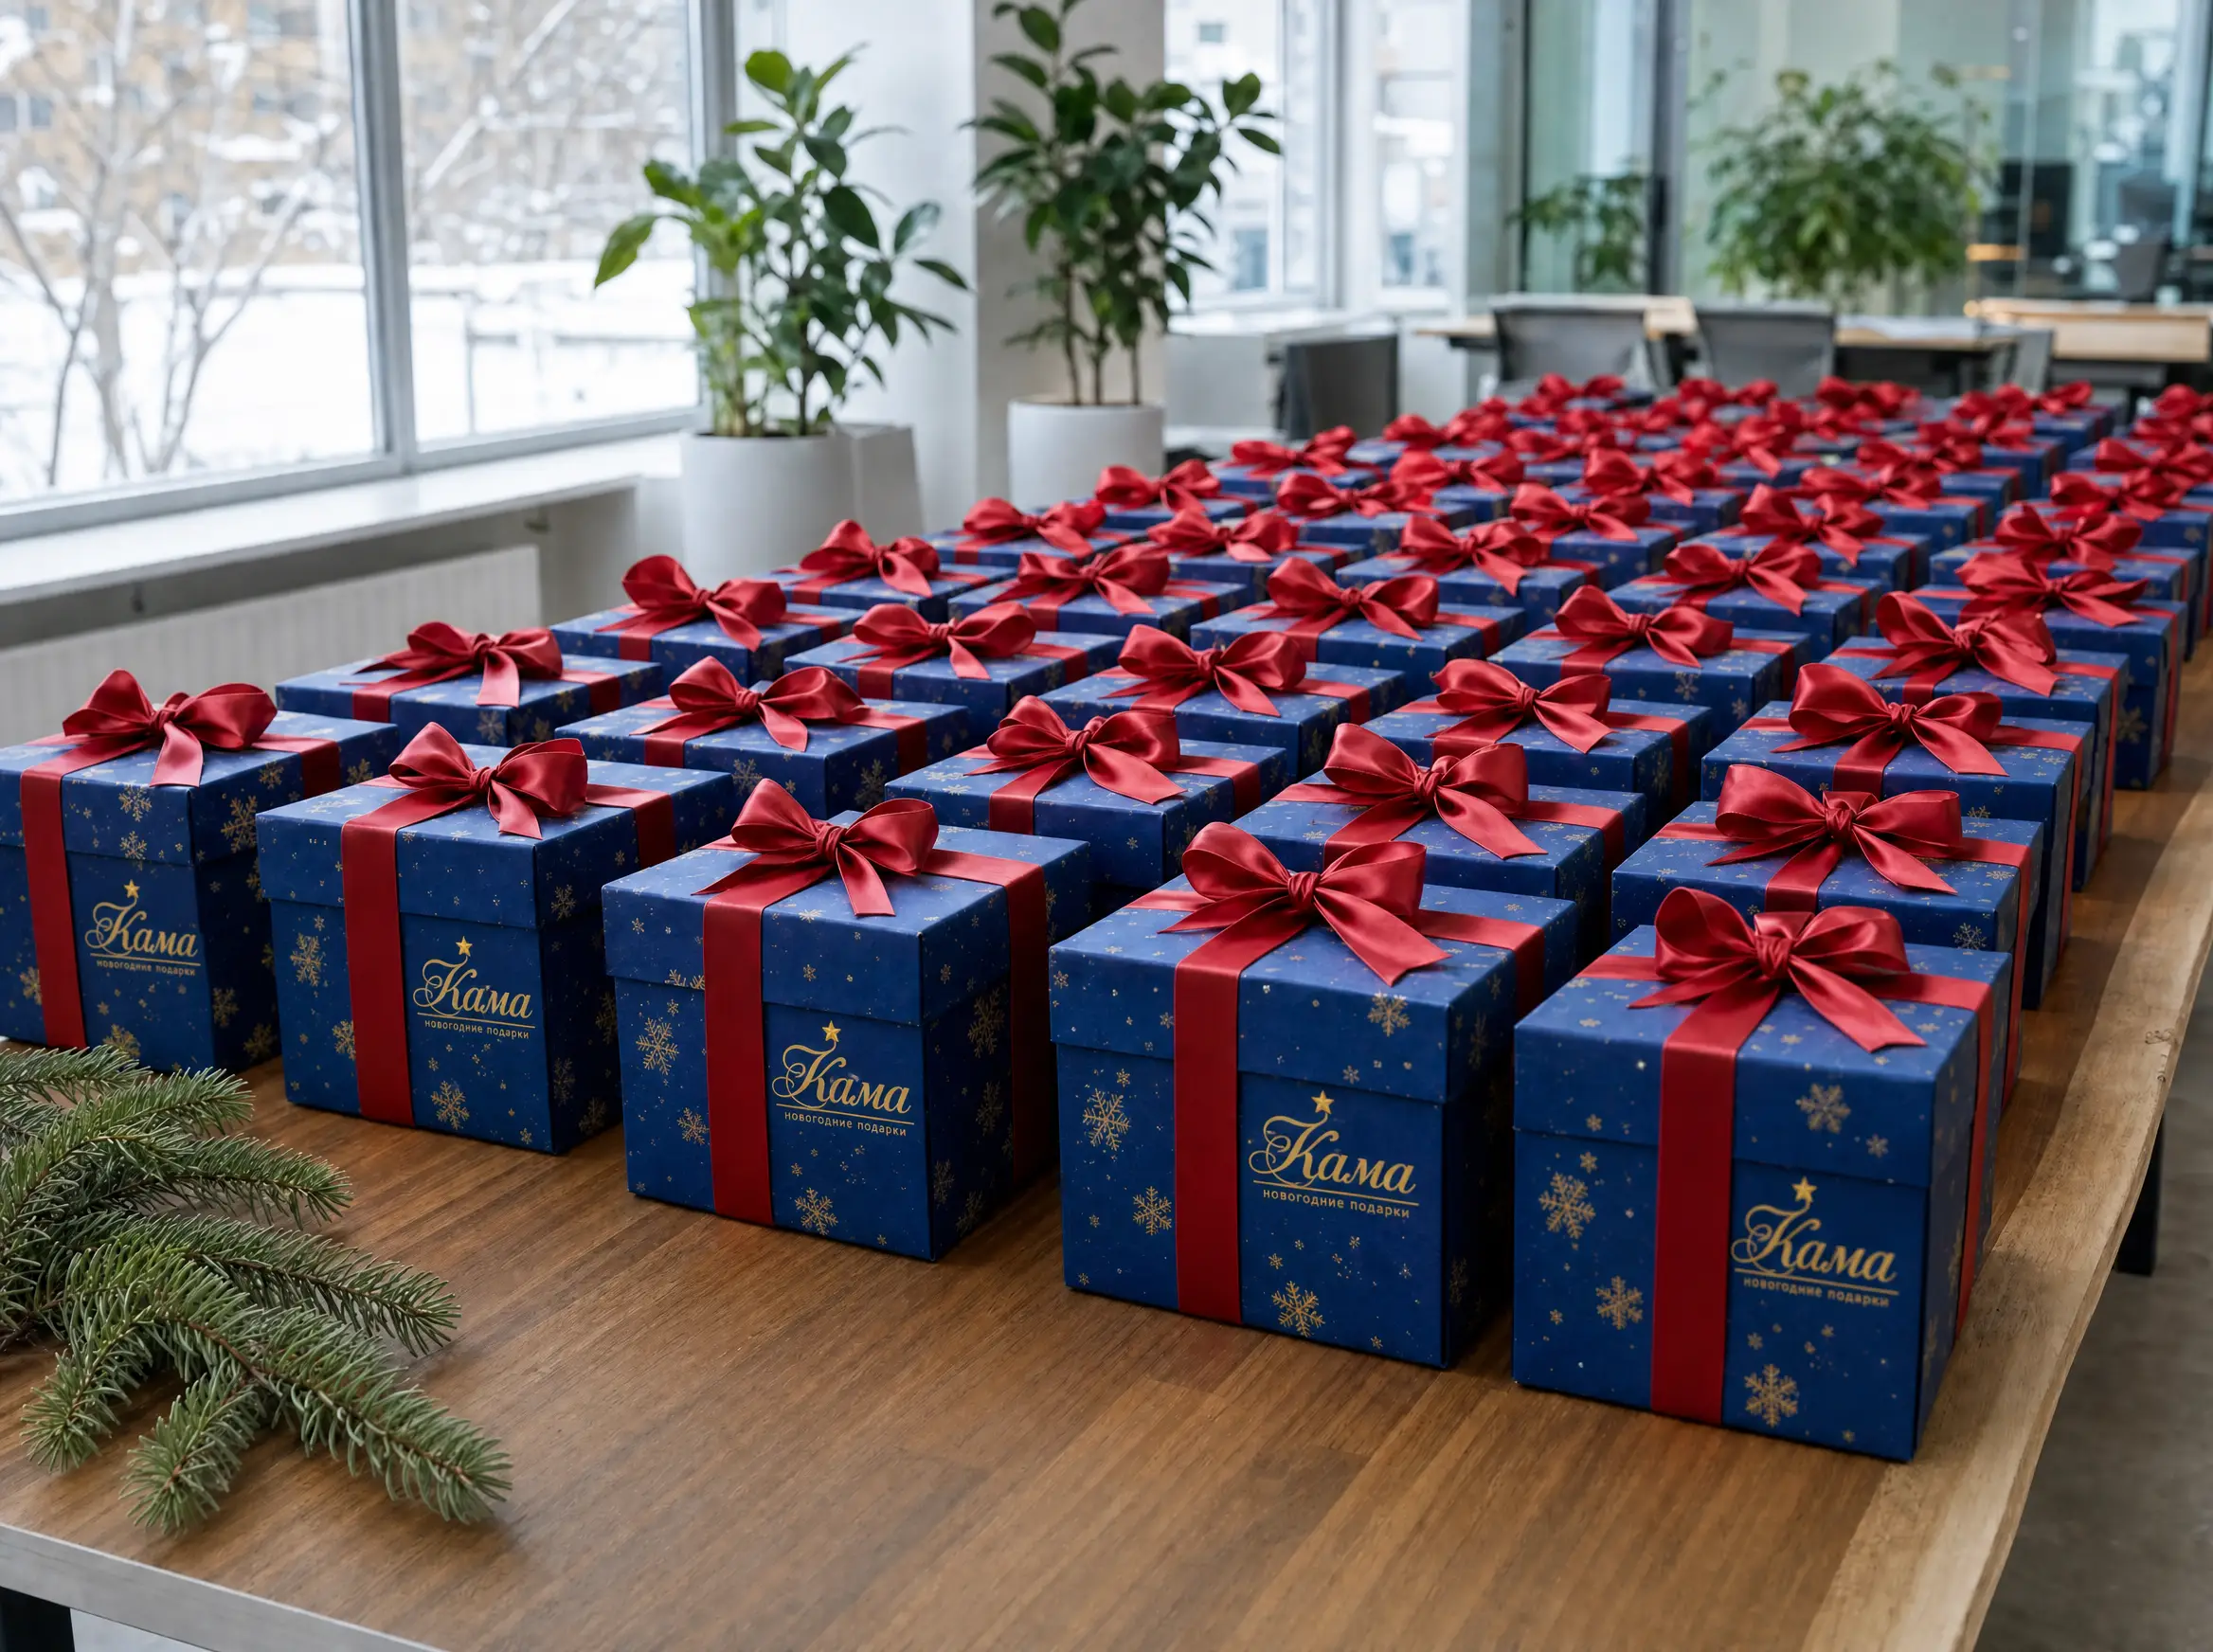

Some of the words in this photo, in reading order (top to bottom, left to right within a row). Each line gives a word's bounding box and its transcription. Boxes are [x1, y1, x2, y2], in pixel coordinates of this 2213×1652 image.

[85, 897, 198, 958] Кама
[97, 960, 152, 973] новогодние
[413, 956, 532, 1018] Кама
[424, 1020, 483, 1033] новогодние
[487, 1026, 530, 1040] подарки
[772, 1041, 911, 1114] Кама
[784, 1111, 853, 1129] новогодние
[857, 1122, 907, 1137] подарки
[1249, 1113, 1416, 1194] Кама
[1263, 1189, 1344, 1209] новогодние
[1350, 1200, 1410, 1218] подарки
[1731, 1201, 1898, 1283] Кама
[1743, 1277, 1823, 1298] новогодние
[1827, 1289, 1889, 1307] подарки
